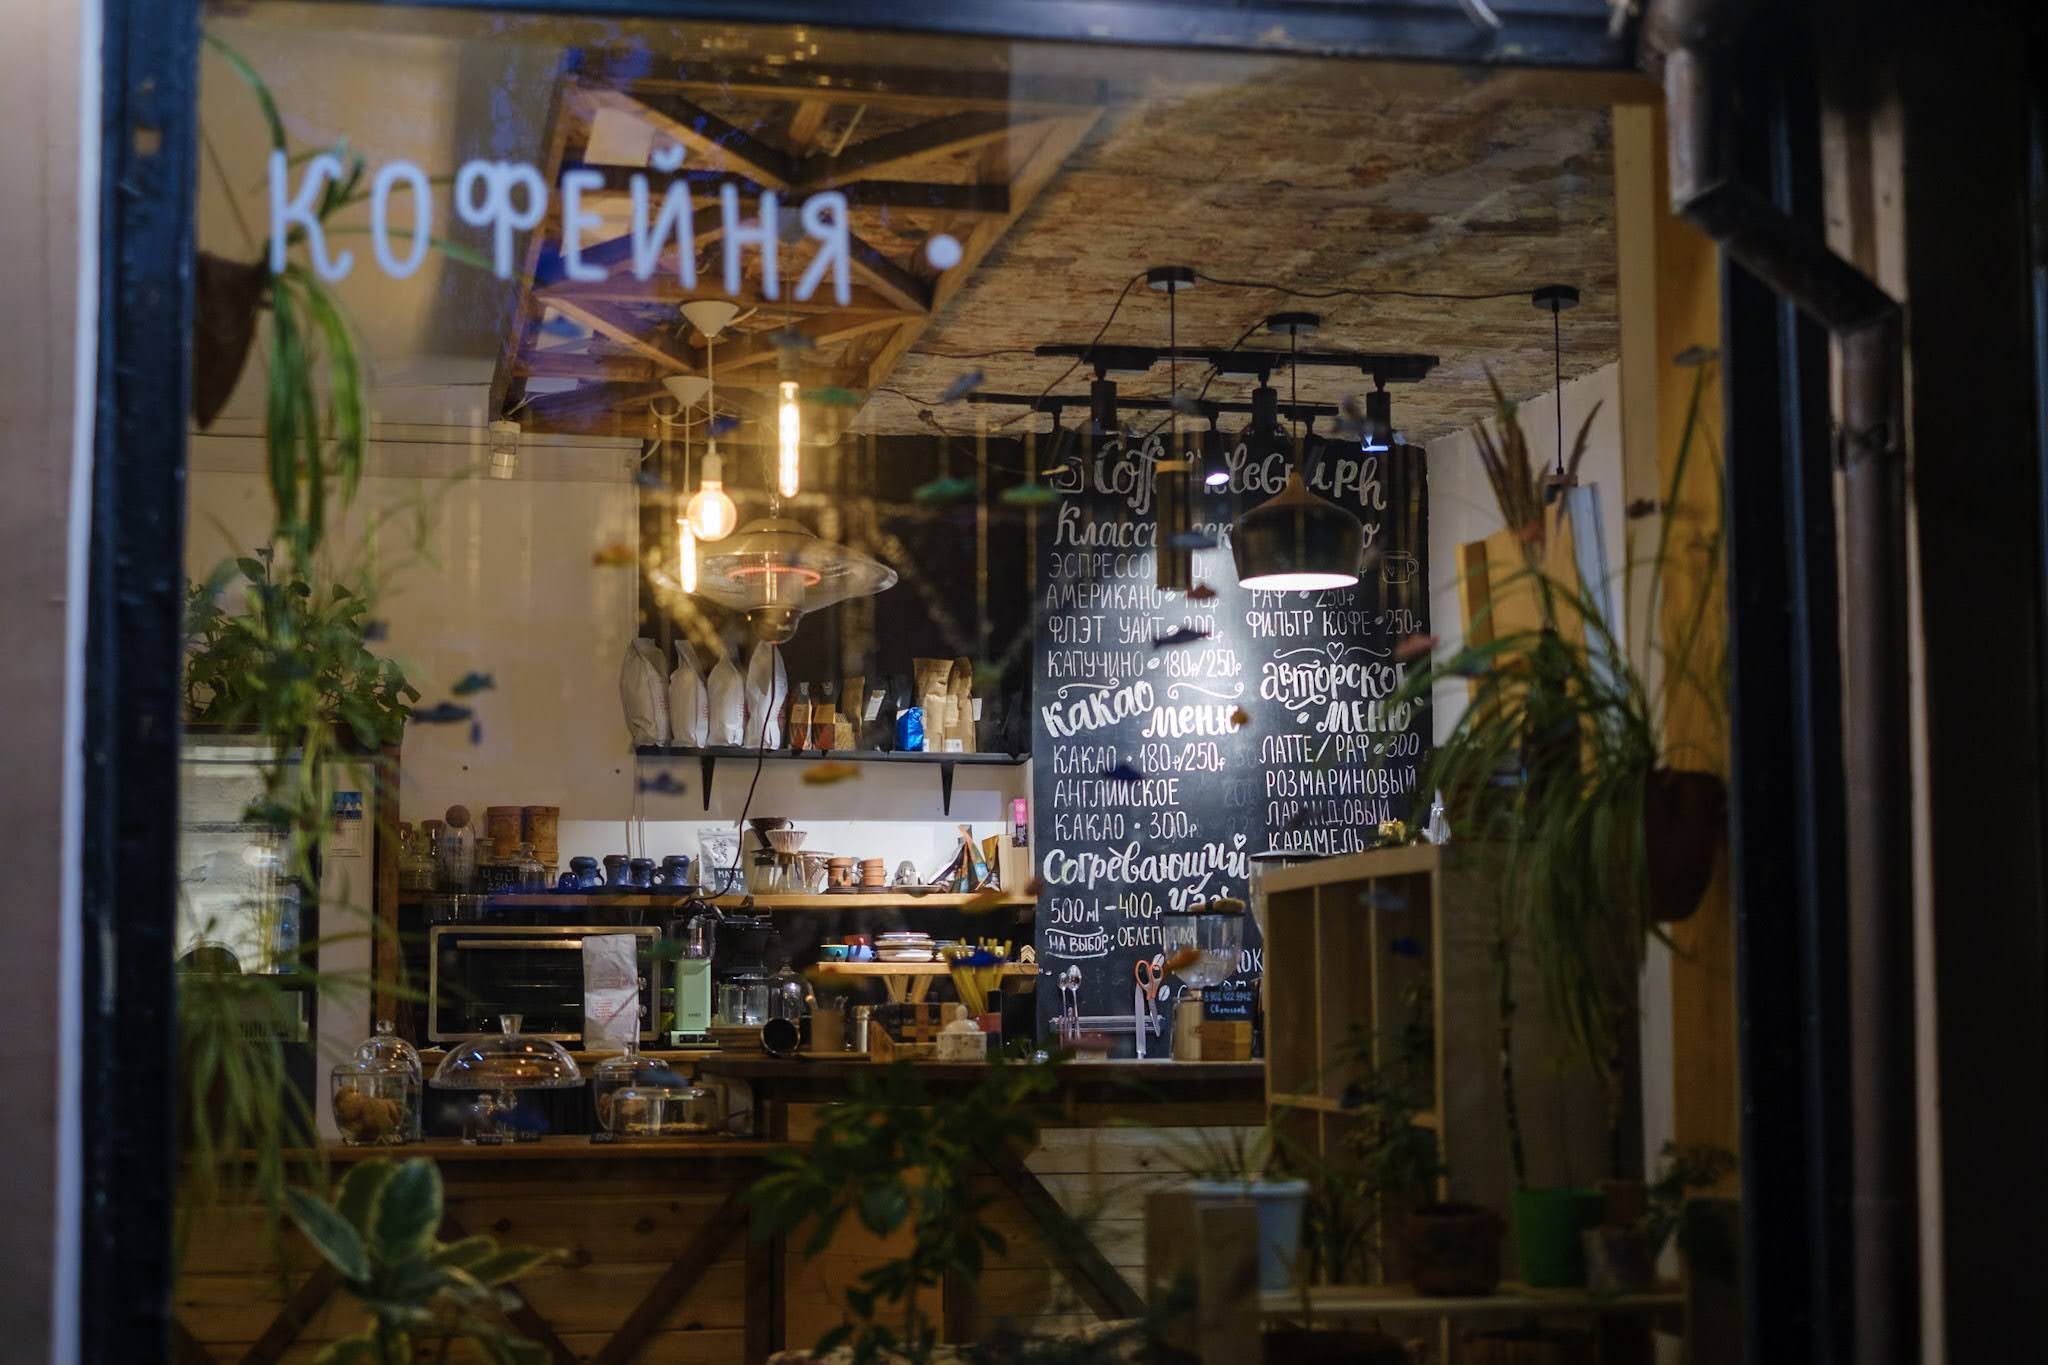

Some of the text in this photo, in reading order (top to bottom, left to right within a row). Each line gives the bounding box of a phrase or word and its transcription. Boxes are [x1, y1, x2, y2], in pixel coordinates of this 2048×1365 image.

[268, 143, 852, 305] КОФЕЙНЯ
[1093, 434, 1165, 515] Coff
[1049, 552, 1152, 579] ЭСПРЕССО
[1046, 583, 1163, 610] АМЕРИКАНО
[1251, 589, 1286, 609] РАФ
[1049, 615, 1106, 644] ФЛЭТ
[1118, 611, 1166, 645] УАЙТ
[1245, 609, 1314, 639] ФИЛЬТР
[1322, 609, 1371, 637] КОФЕ
[1047, 650, 1144, 679] КАПУЧИНО
[1053, 745, 1118, 775] КАКАО
[1265, 765, 1417, 798] РОЗМАРИНОВЫЙ
[1054, 813, 1125, 841] КАКАО
[1268, 828, 1365, 854] КАРАМЕЛЬ
[1042, 840, 1250, 894] Согревающий
[1048, 934, 1067, 951] НА
